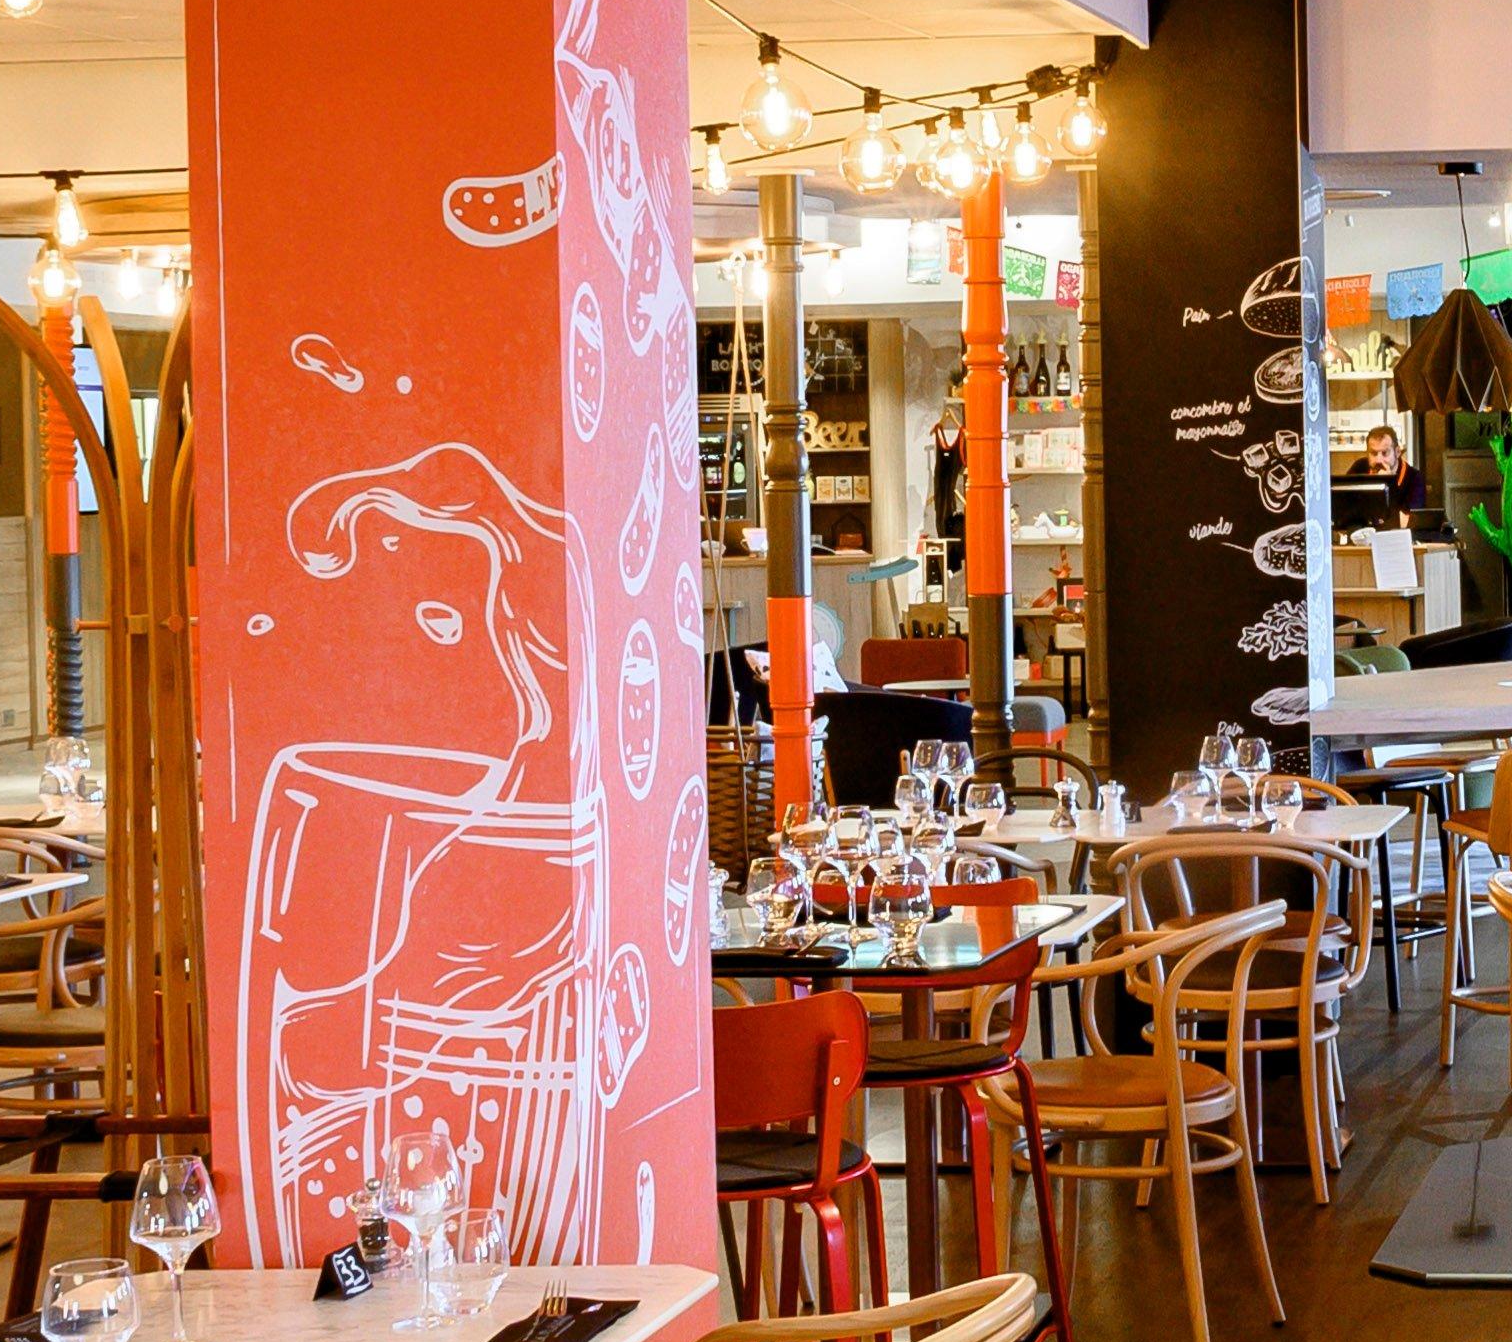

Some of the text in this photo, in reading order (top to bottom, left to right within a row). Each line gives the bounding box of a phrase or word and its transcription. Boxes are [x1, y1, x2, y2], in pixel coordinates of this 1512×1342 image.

[1183, 307, 1211, 327] Pain
[1171, 400, 1233, 420] concombre
[803, 411, 867, 449] Beer
[1176, 420, 1246, 442] mayonnaise
[1189, 517, 1233, 540] viande
[1217, 721, 1244, 737] Pain
[336, 1255, 366, 1287] 33
